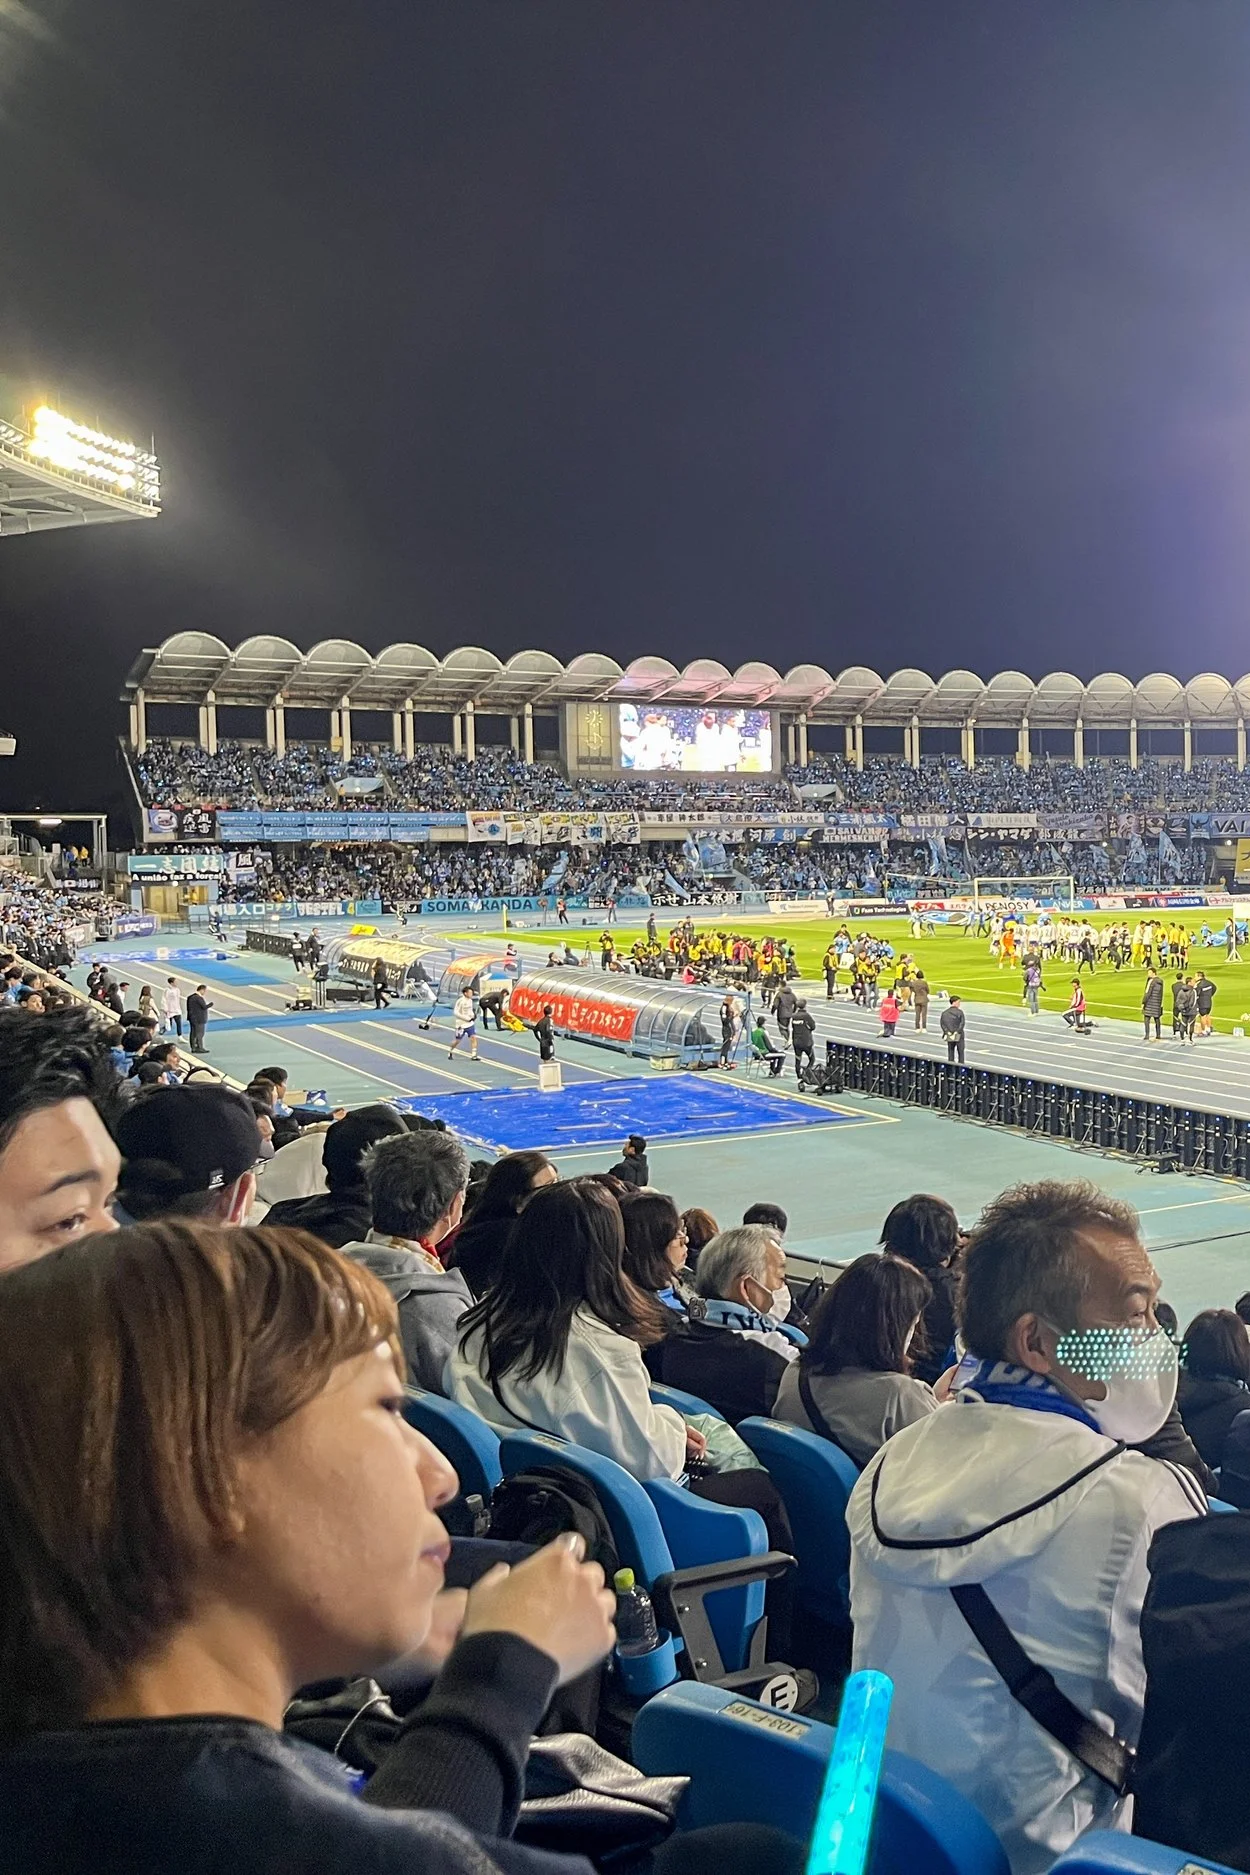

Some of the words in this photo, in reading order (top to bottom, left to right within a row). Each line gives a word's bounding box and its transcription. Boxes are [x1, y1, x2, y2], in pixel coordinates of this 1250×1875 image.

[1214, 819, 1245, 834] VAI
[427, 899, 470, 912] SOMA
[481, 898, 533, 911] KANDA
